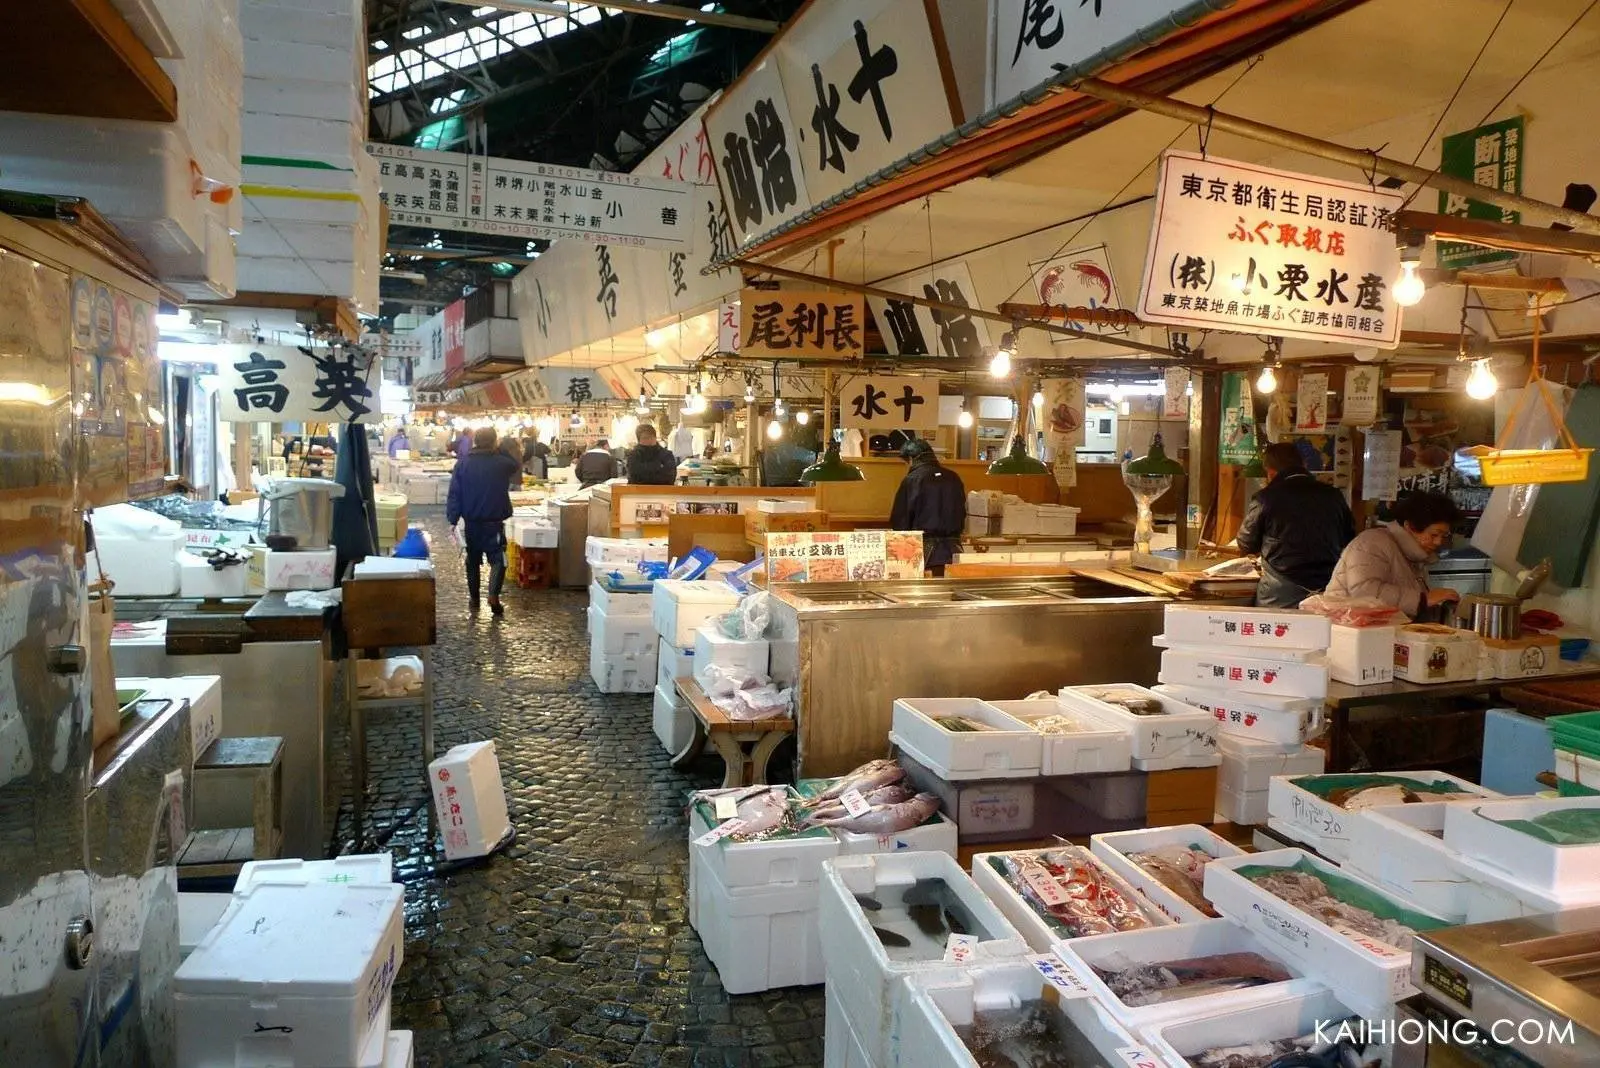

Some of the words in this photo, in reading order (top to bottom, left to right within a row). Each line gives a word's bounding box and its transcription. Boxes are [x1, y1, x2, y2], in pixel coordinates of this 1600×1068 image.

[1227, 215, 1346, 257] ふぐ取扱店
[745, 300, 862, 350] 尾利長
[1160, 293, 1386, 334] 東京築地魚市場ふぐ卸売協同組合
[233, 351, 375, 414] 高英
[568, 376, 594, 406] 福
[851, 383, 925, 422] 水十
